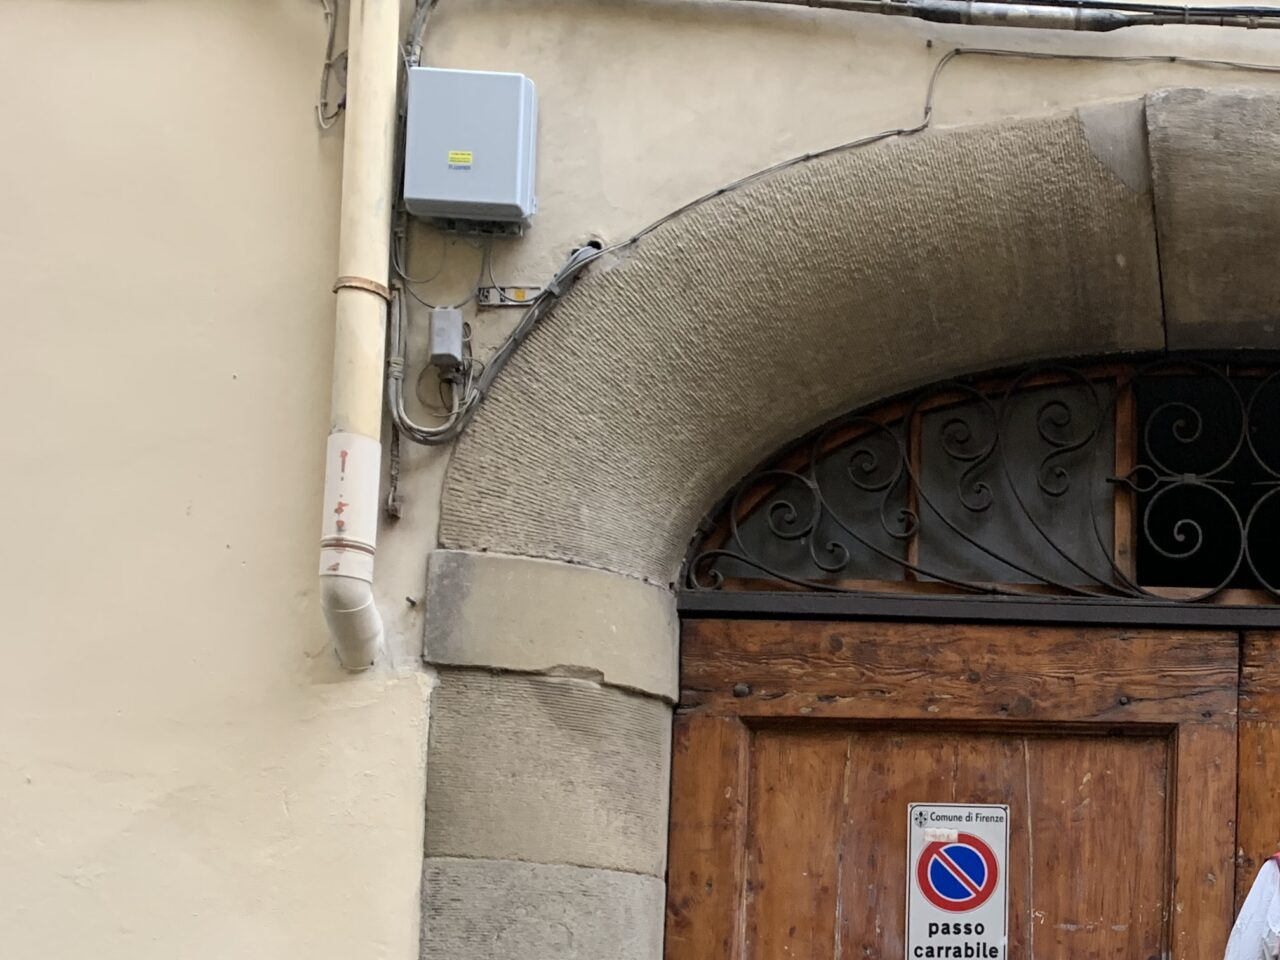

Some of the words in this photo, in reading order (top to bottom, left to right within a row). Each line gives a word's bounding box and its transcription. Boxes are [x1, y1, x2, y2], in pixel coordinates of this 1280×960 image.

[929, 811, 963, 822] Comune
[965, 811, 973, 822] di
[975, 812, 1004, 823] Firenze
[928, 922, 985, 938] passo
[913, 941, 999, 958] carrabile
